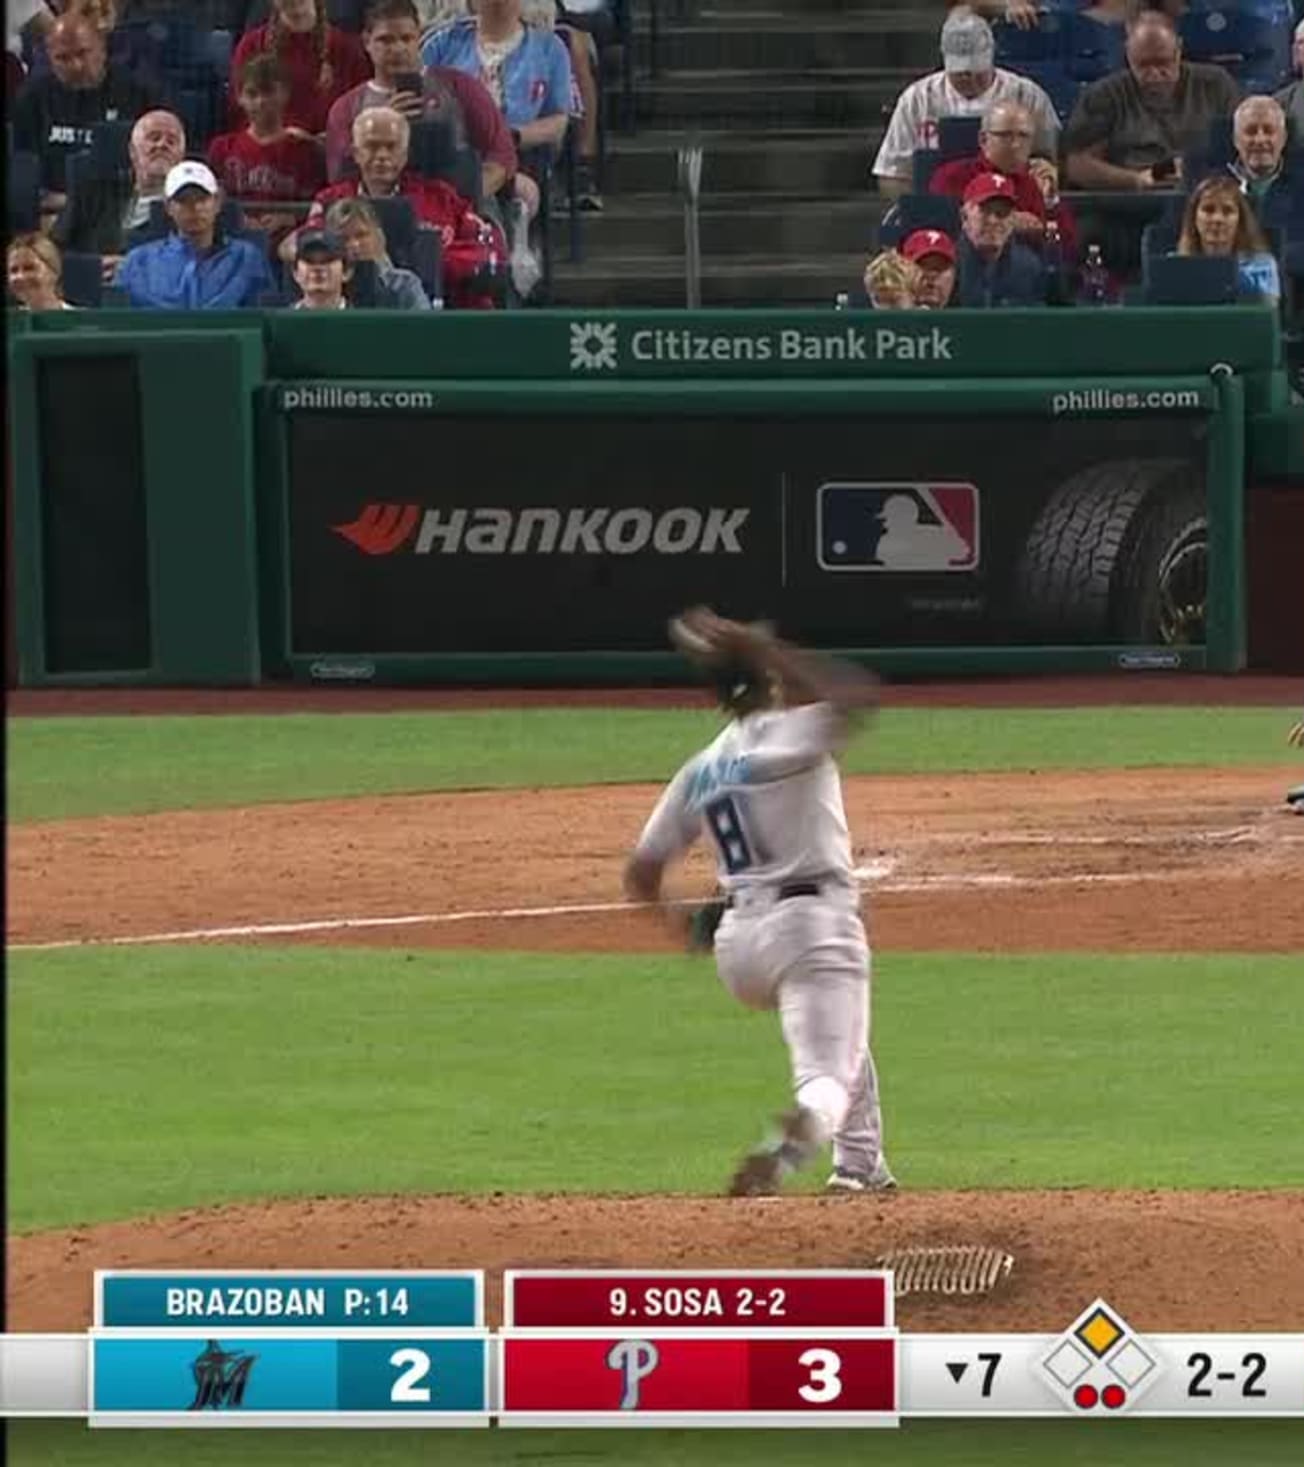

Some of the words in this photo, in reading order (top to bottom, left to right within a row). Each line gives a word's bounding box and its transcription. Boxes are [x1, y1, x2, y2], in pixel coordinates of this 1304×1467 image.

[631, 330, 772, 360] Citizens
[780, 328, 867, 360] Bank
[876, 328, 953, 360] Park
[283, 388, 433, 409] phillies.com
[1052, 389, 1200, 416] phillies.com
